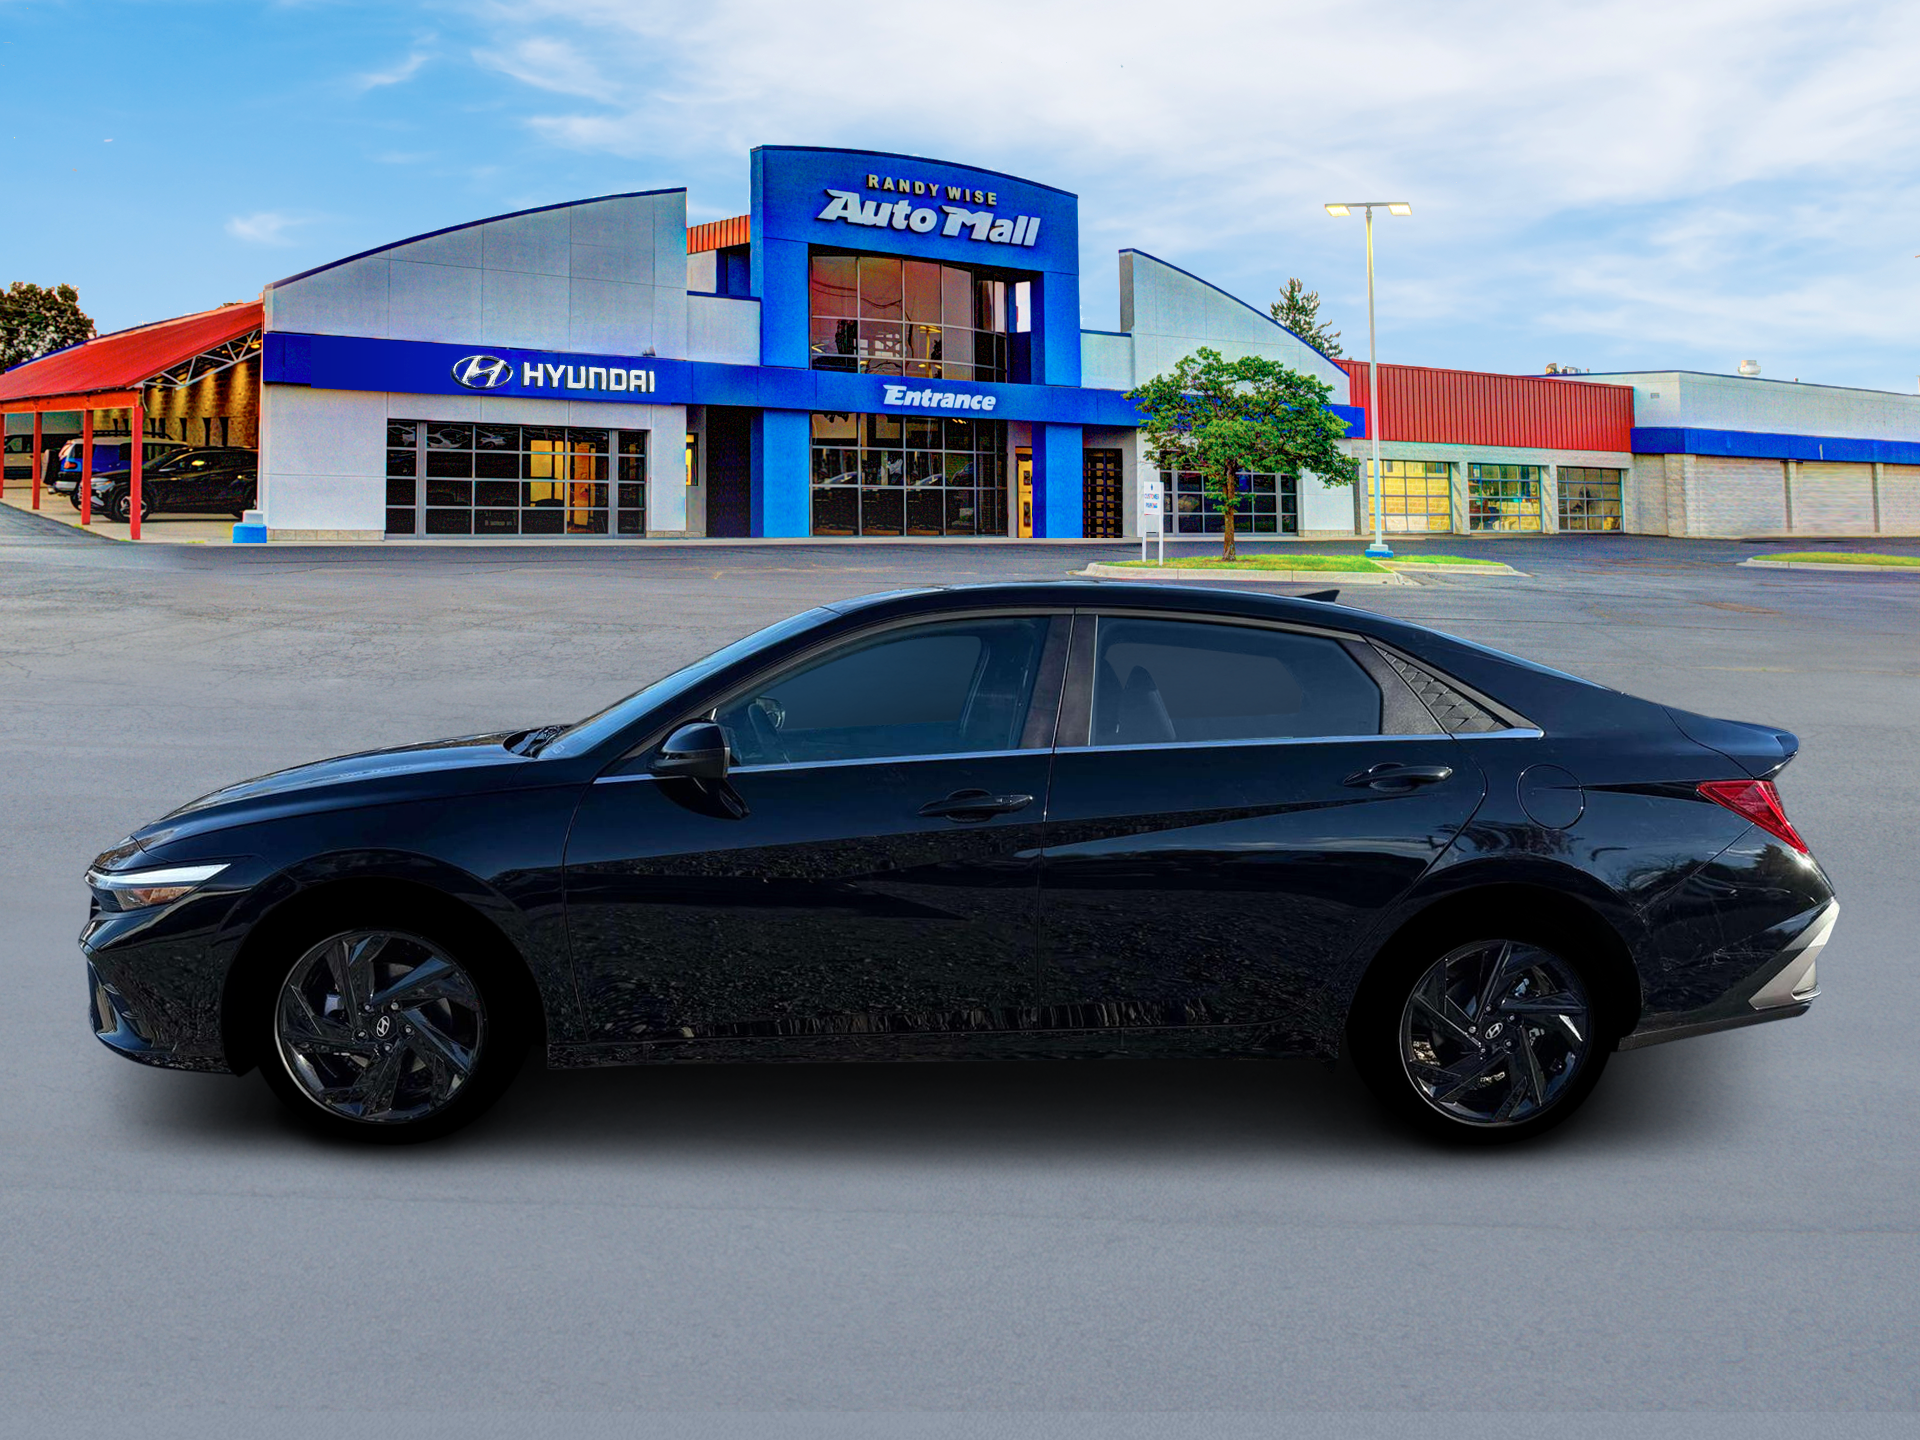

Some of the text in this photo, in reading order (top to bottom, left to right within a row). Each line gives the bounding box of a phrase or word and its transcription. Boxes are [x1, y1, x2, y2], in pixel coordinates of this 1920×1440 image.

[866, 174, 998, 206] RANDY WISE
[817, 189, 1041, 246] Auto Mall
[522, 362, 656, 393] HYUNDAI
[883, 385, 997, 411] Entrance
